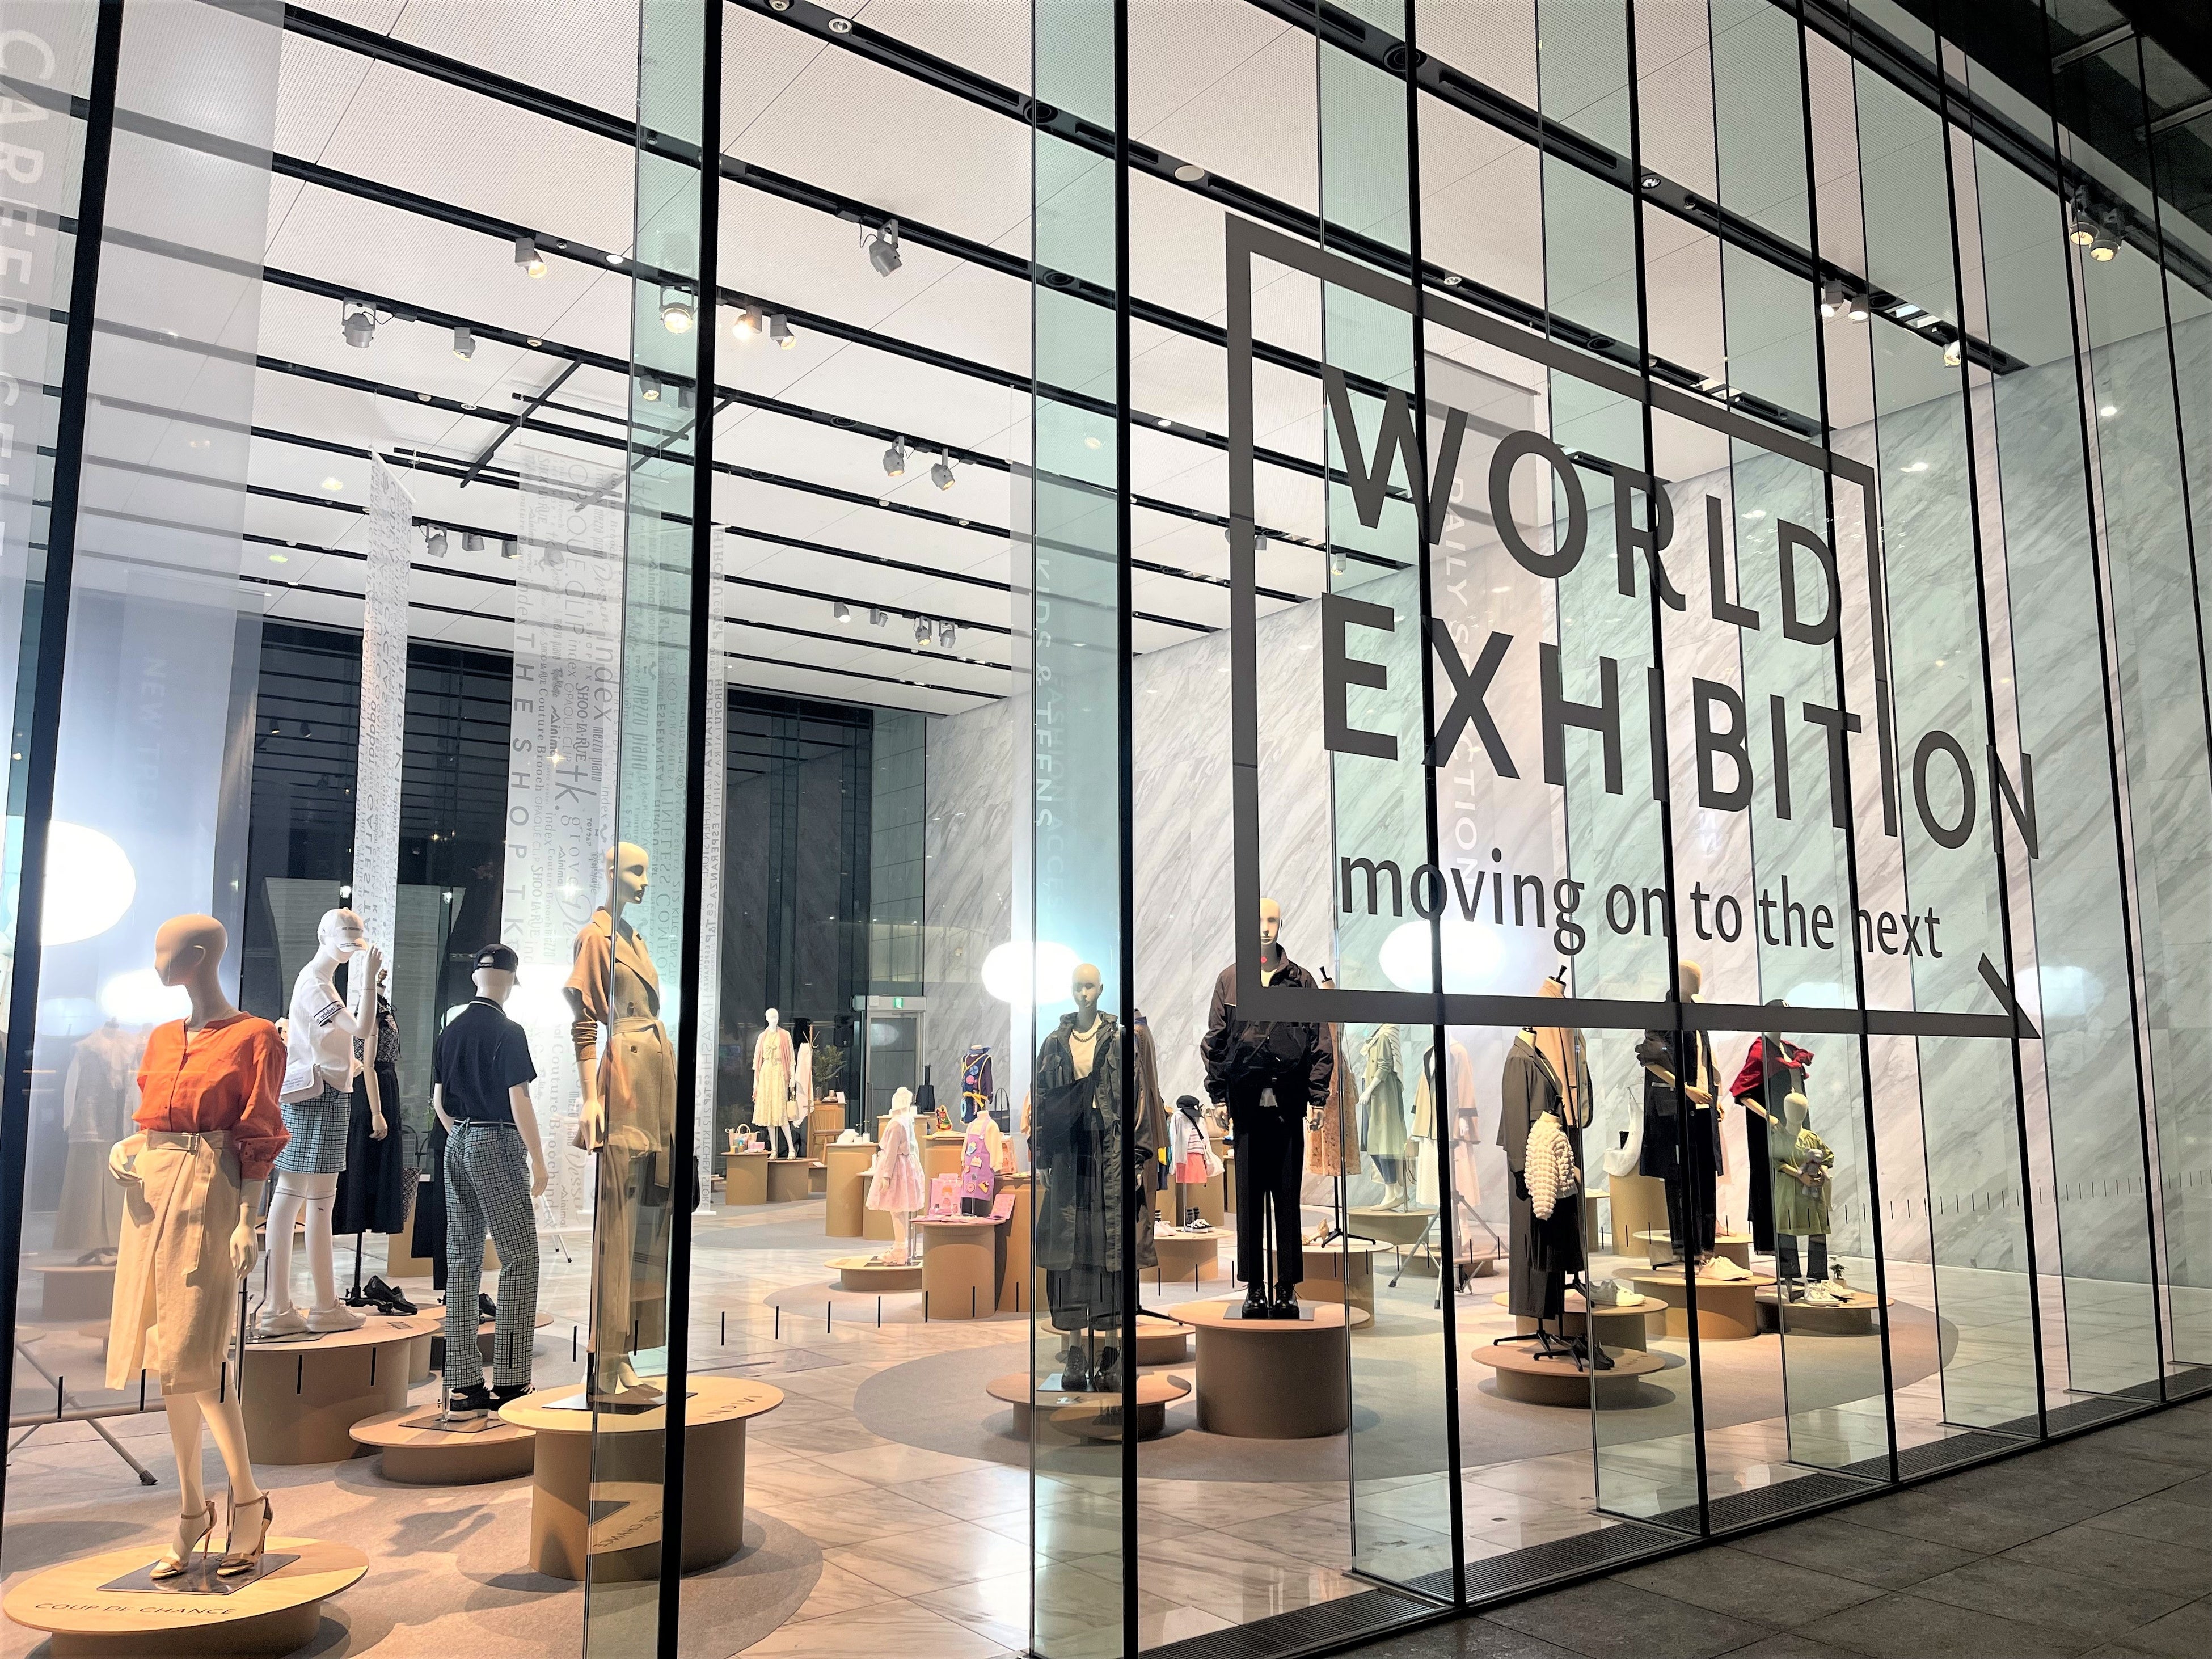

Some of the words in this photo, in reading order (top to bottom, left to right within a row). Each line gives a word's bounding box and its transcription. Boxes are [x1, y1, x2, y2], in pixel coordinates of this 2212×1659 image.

[1321, 363, 1841, 645] WORLD
[1446, 477, 1468, 607] DAILY
[1036, 559, 1051, 649] KIDS
[513, 633, 535, 714] THE
[585, 665, 593, 681] TK
[594, 636, 620, 721] index
[1036, 660, 1051, 686] &
[537, 688, 548, 741] Couture
[632, 685, 649, 726] mezzo
[1322, 593, 2039, 860] EXHIBITION
[549, 705, 561, 761] Minima
[593, 726, 604, 753] mezzo
[624, 732, 652, 770] piano
[1448, 620, 1478, 886] SECTION
[535, 746, 546, 791] Brooch
[588, 757, 606, 782] piano
[1036, 702, 1053, 828] TEENS
[508, 738, 533, 859] SHOP
[600, 786, 612, 819] index
[544, 813, 556, 846] index
[560, 814, 581, 886] grove
[545, 847, 556, 888] Couture
[504, 885, 526, 935] TK
[544, 893, 554, 931] Brooch
[1341, 848, 1584, 955] moving
[1606, 880, 1671, 938] on
[1690, 880, 1742, 943] to
[1759, 875, 1834, 949] the
[1856, 905, 1941, 959] next
[548, 1042, 564, 1112] Couture
[546, 1118, 562, 1180] Brooch
[698, 1395, 762, 1417] INDIVI
